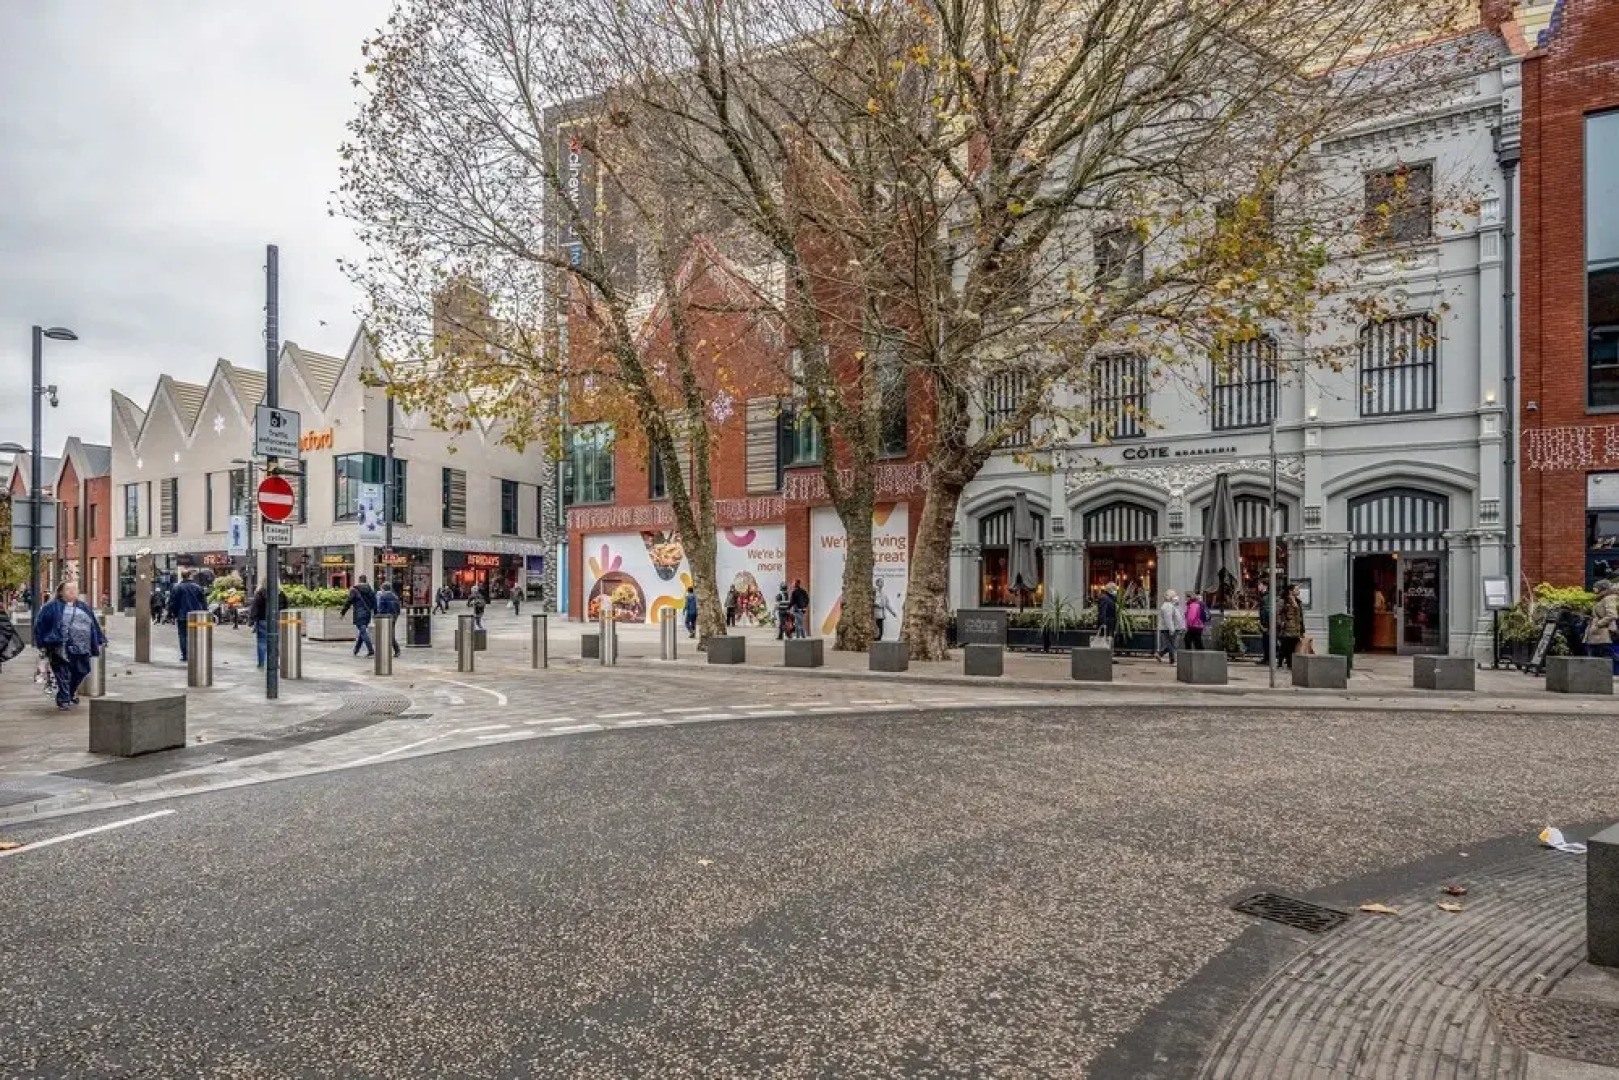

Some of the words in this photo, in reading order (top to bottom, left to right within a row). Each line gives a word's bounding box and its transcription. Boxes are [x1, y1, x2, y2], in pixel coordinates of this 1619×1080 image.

[268, 429, 289, 440] Traffic
[258, 437, 297, 448] enforcement
[265, 446, 292, 455] cameras
[1123, 444, 1169, 460] CÔTE
[267, 526, 289, 535] Except
[267, 535, 288, 543] cycles
[873, 534, 906, 550] rving
[747, 548, 775, 559] We're
[757, 562, 783, 571] more
